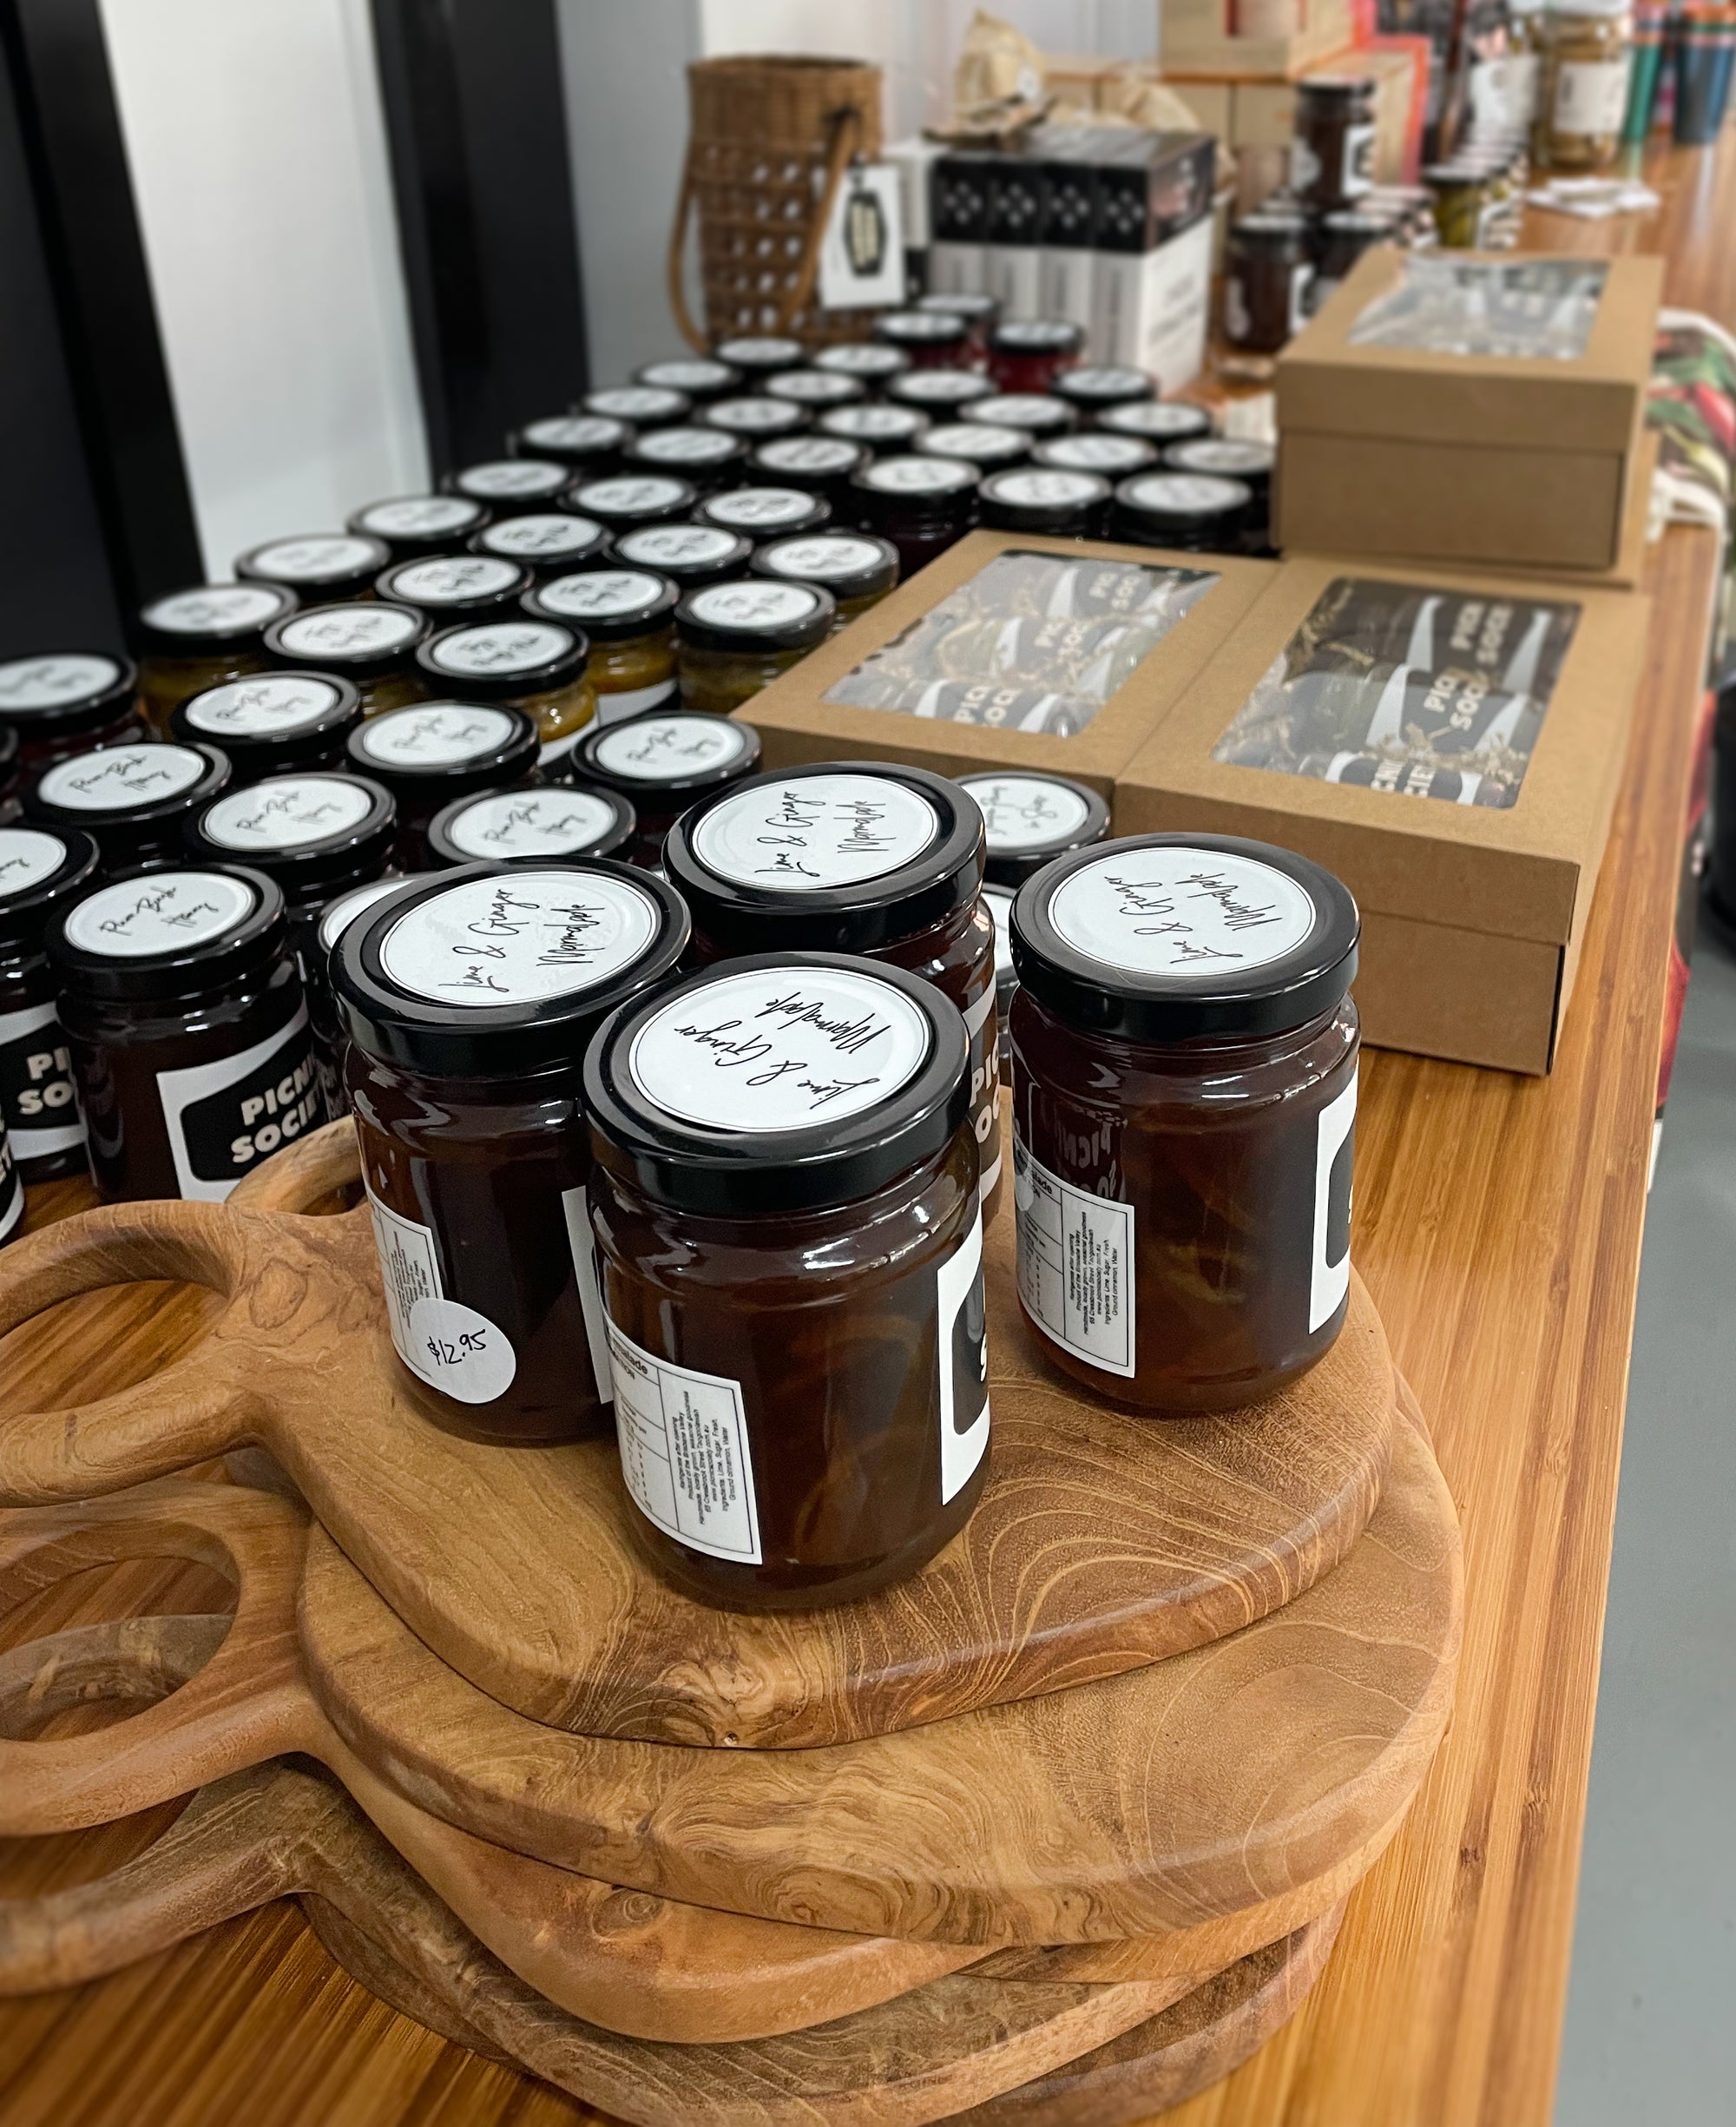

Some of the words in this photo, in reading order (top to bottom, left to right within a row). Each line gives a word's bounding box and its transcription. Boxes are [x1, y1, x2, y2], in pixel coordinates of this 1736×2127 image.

[765, 791, 826, 827] Ginger
[833, 800, 898, 854] Marmalade
[757, 834, 808, 847] &
[754, 853, 820, 878] Lime
[467, 888, 541, 936] Ginger
[1103, 875, 1175, 916] Ginger
[1174, 873, 1283, 932] Marmalade
[535, 903, 606, 967] Marmalade
[1134, 922, 1194, 935] &
[451, 945, 507, 959] &
[1168, 940, 1244, 965] Lime
[437, 965, 510, 993] Lime
[753, 991, 891, 1054] Marmalade
[674, 1020, 773, 1067] Ginger
[745, 1059, 808, 1086] &
[797, 1077, 882, 1110] Lime
[426, 1328, 488, 1366] $12.95
